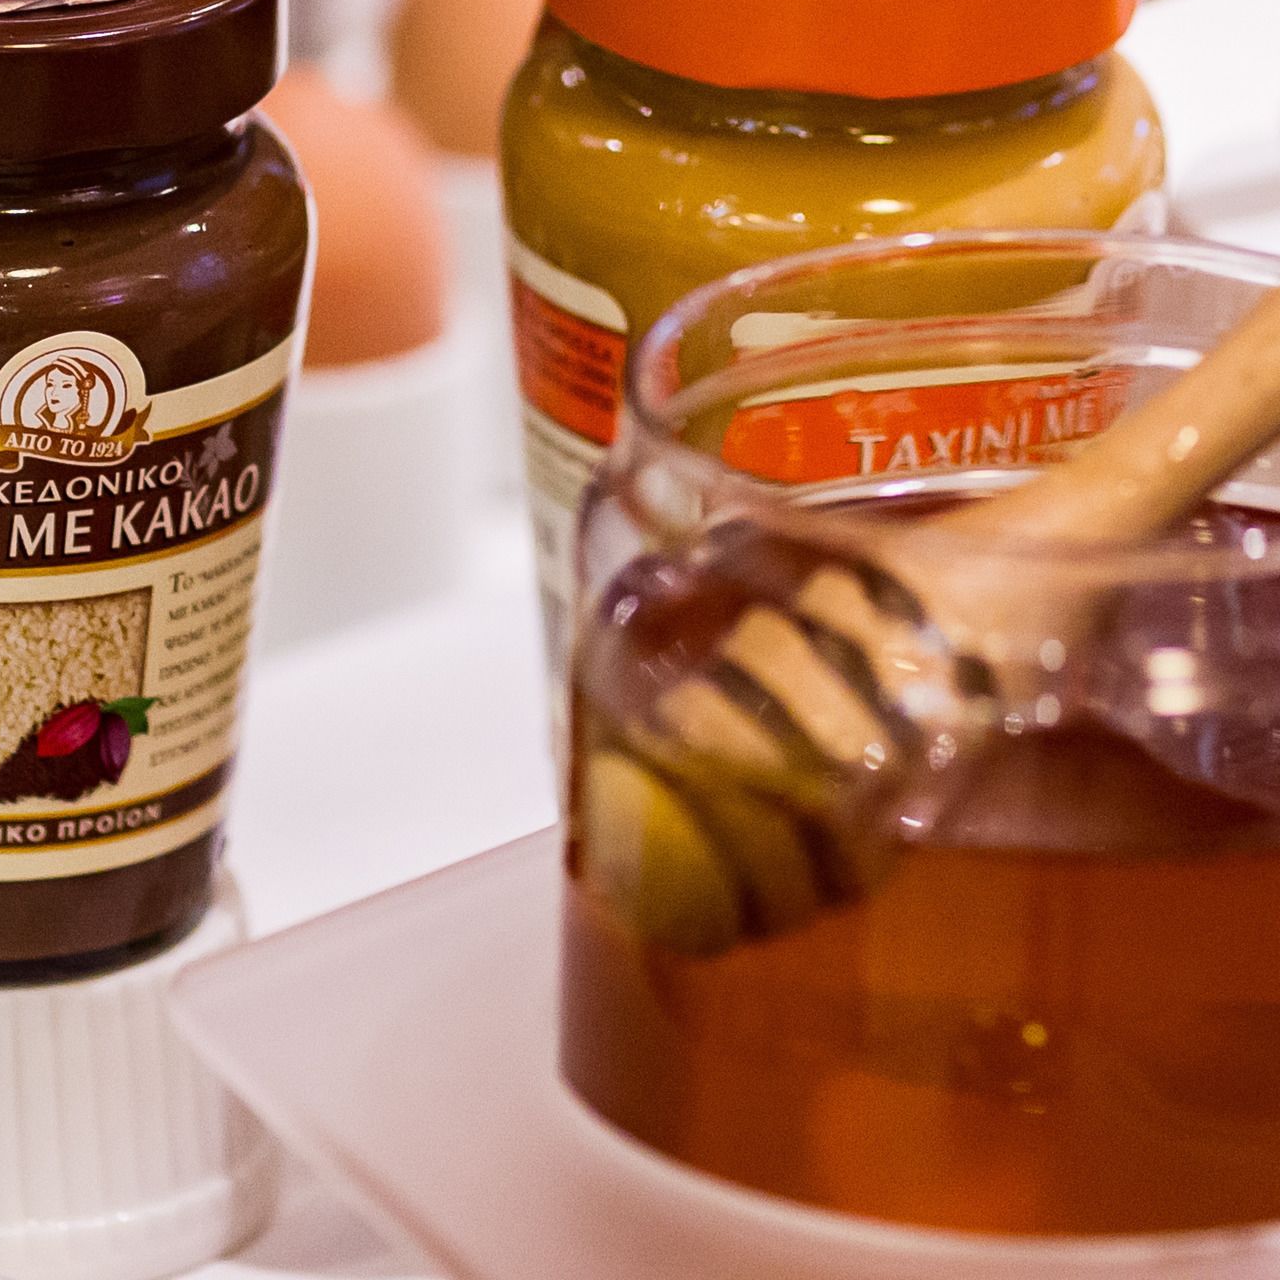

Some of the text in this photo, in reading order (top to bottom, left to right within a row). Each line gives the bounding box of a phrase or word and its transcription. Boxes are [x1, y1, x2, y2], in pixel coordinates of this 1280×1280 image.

[4, 431, 124, 459] ΑΠΟ ΤΟ 1924
[10, 507, 94, 560] ΜΕ
[111, 461, 260, 551] ΚΑΚΑΟ
